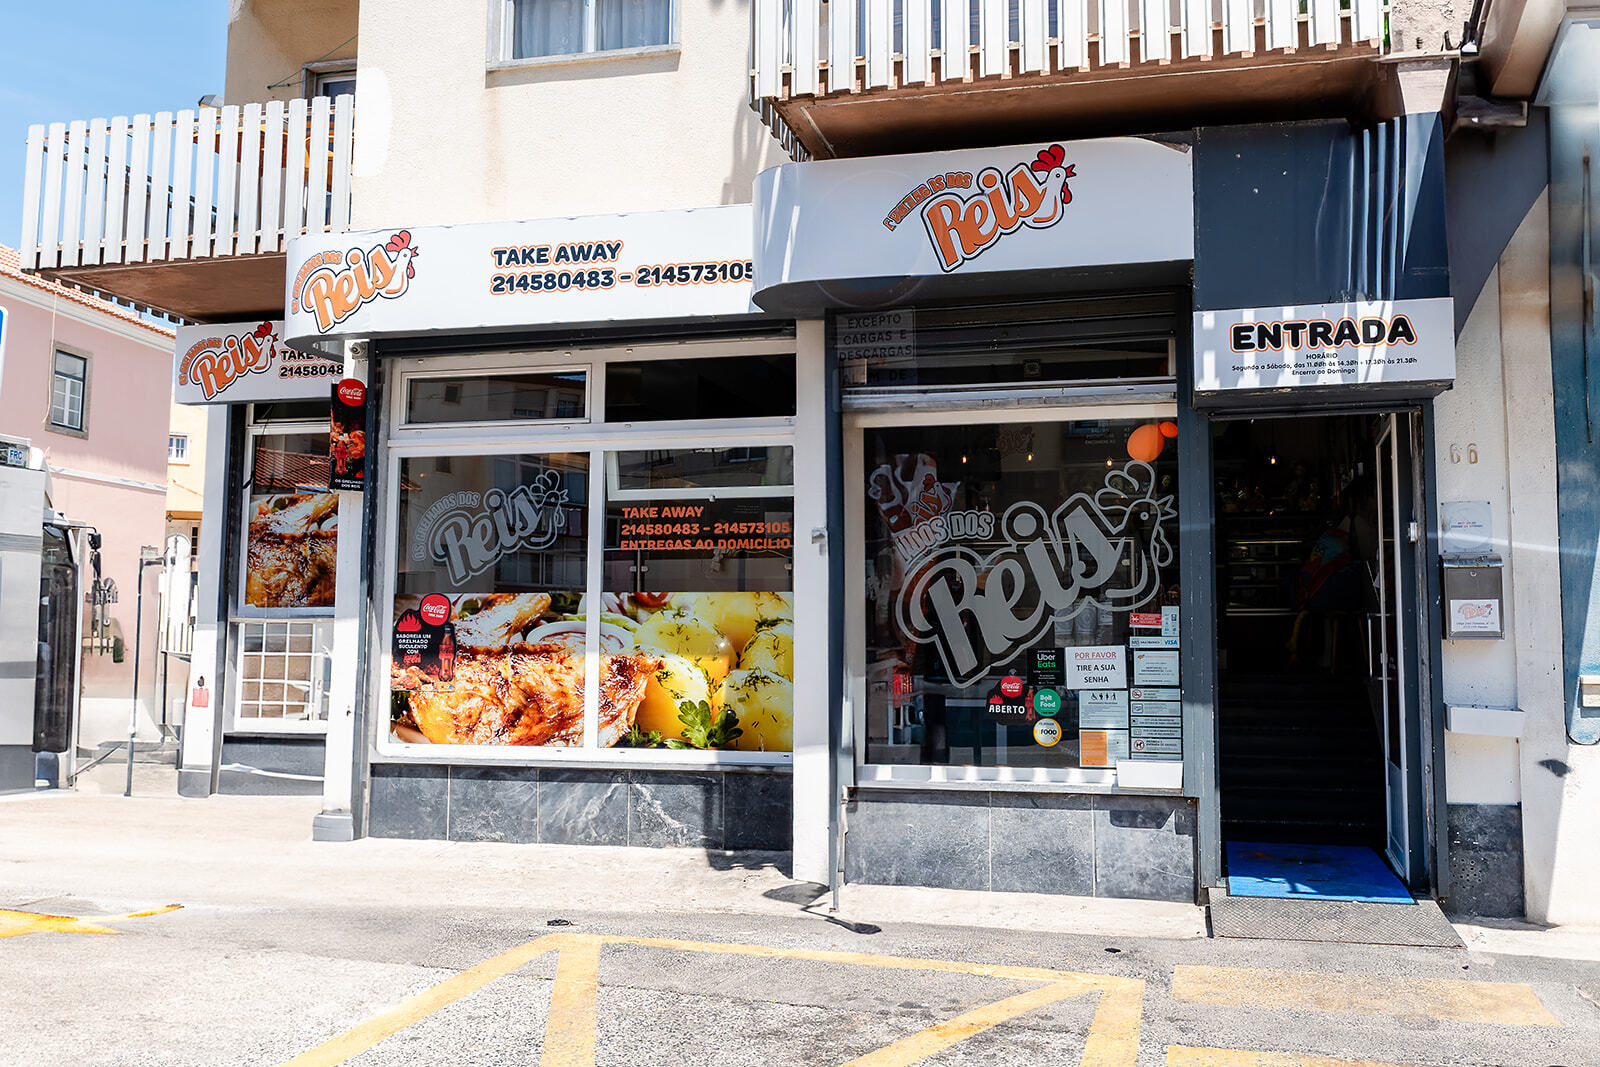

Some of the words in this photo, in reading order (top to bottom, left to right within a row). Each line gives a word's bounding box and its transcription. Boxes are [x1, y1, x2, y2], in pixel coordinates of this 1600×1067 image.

[925, 168, 1049, 269] Reis
[493, 246, 551, 267] TAKE
[554, 242, 622, 263] AWAY
[491, 269, 615, 293] 214580483
[303, 248, 398, 331] Reis
[847, 313, 902, 329] EXCEPTO
[843, 330, 893, 346] CARGAS
[1232, 316, 1416, 351] ENTRADA
[280, 349, 315, 361] TAKE
[839, 344, 913, 361] DESCARGAS
[1305, 351, 1338, 360] HORÁRIO
[192, 334, 264, 398] Reis
[1231, 363, 1260, 371] Segunda
[1293, 360, 1306, 368] das
[1326, 368, 1356, 376] Domingo
[457, 491, 480, 508] DOS
[621, 506, 659, 519] TAKE
[661, 506, 704, 518] AWAY
[620, 523, 700, 536] 214580483
[713, 521, 791, 535] 214573105
[949, 511, 994, 540] DOS
[433, 490, 543, 582] Reis
[619, 539, 692, 551] ENTREGAS
[694, 538, 714, 550] AO
[907, 503, 1128, 679] Reis
[1036, 653, 1056, 662] Uber
[1074, 651, 1091, 660] POR
[1091, 651, 1117, 659] FAVOR
[1037, 661, 1056, 669] Eats
[1076, 664, 1092, 672] TIRE
[1083, 676, 1109, 684] SENHA
[988, 704, 1026, 715] ABERTO
[1040, 701, 1056, 709] Food
